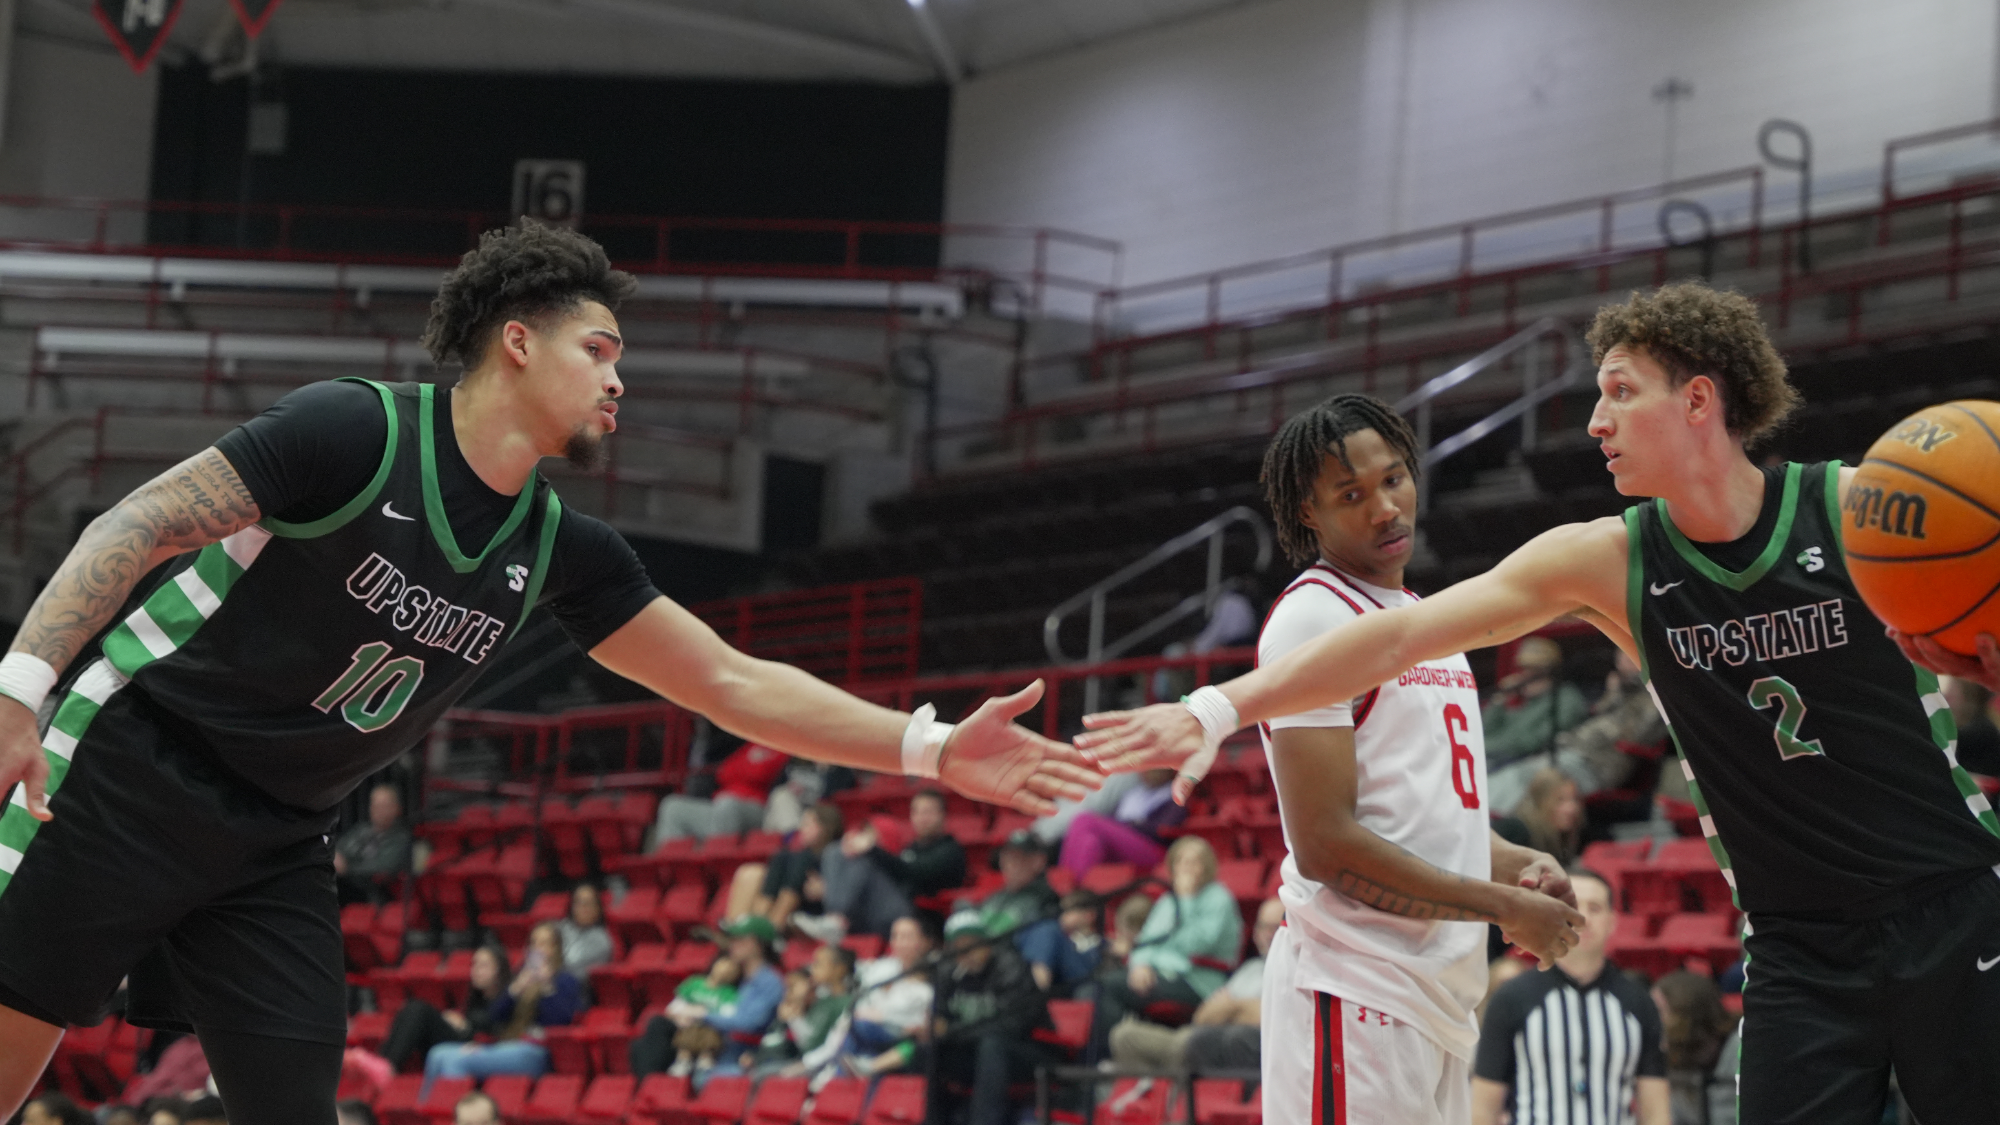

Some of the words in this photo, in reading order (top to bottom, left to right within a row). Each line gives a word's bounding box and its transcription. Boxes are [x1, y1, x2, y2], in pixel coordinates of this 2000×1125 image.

[522, 170, 573, 221] 16
[346, 552, 505, 665] UPSTATE
[1667, 598, 1848, 670] UPSTATE
[311, 641, 424, 733] 10
[1747, 676, 1826, 761] 2
[1443, 703, 1480, 809] 6
